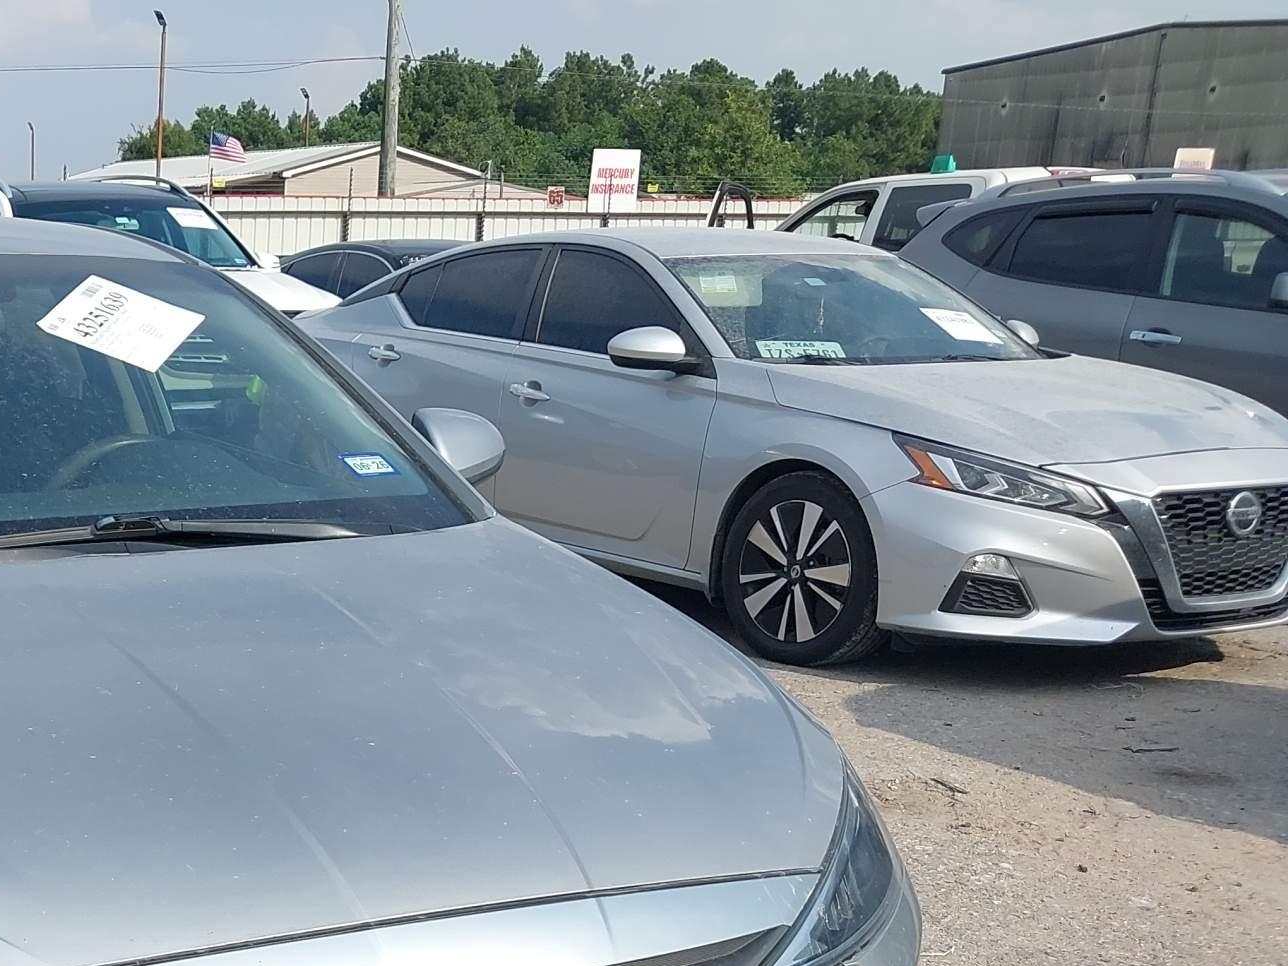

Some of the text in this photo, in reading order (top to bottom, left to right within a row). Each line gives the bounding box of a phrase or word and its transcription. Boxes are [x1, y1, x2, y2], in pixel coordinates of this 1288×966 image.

[597, 167, 635, 179] MERCURY
[591, 183, 636, 194] INSURANCE
[73, 291, 129, 338] 43251639
